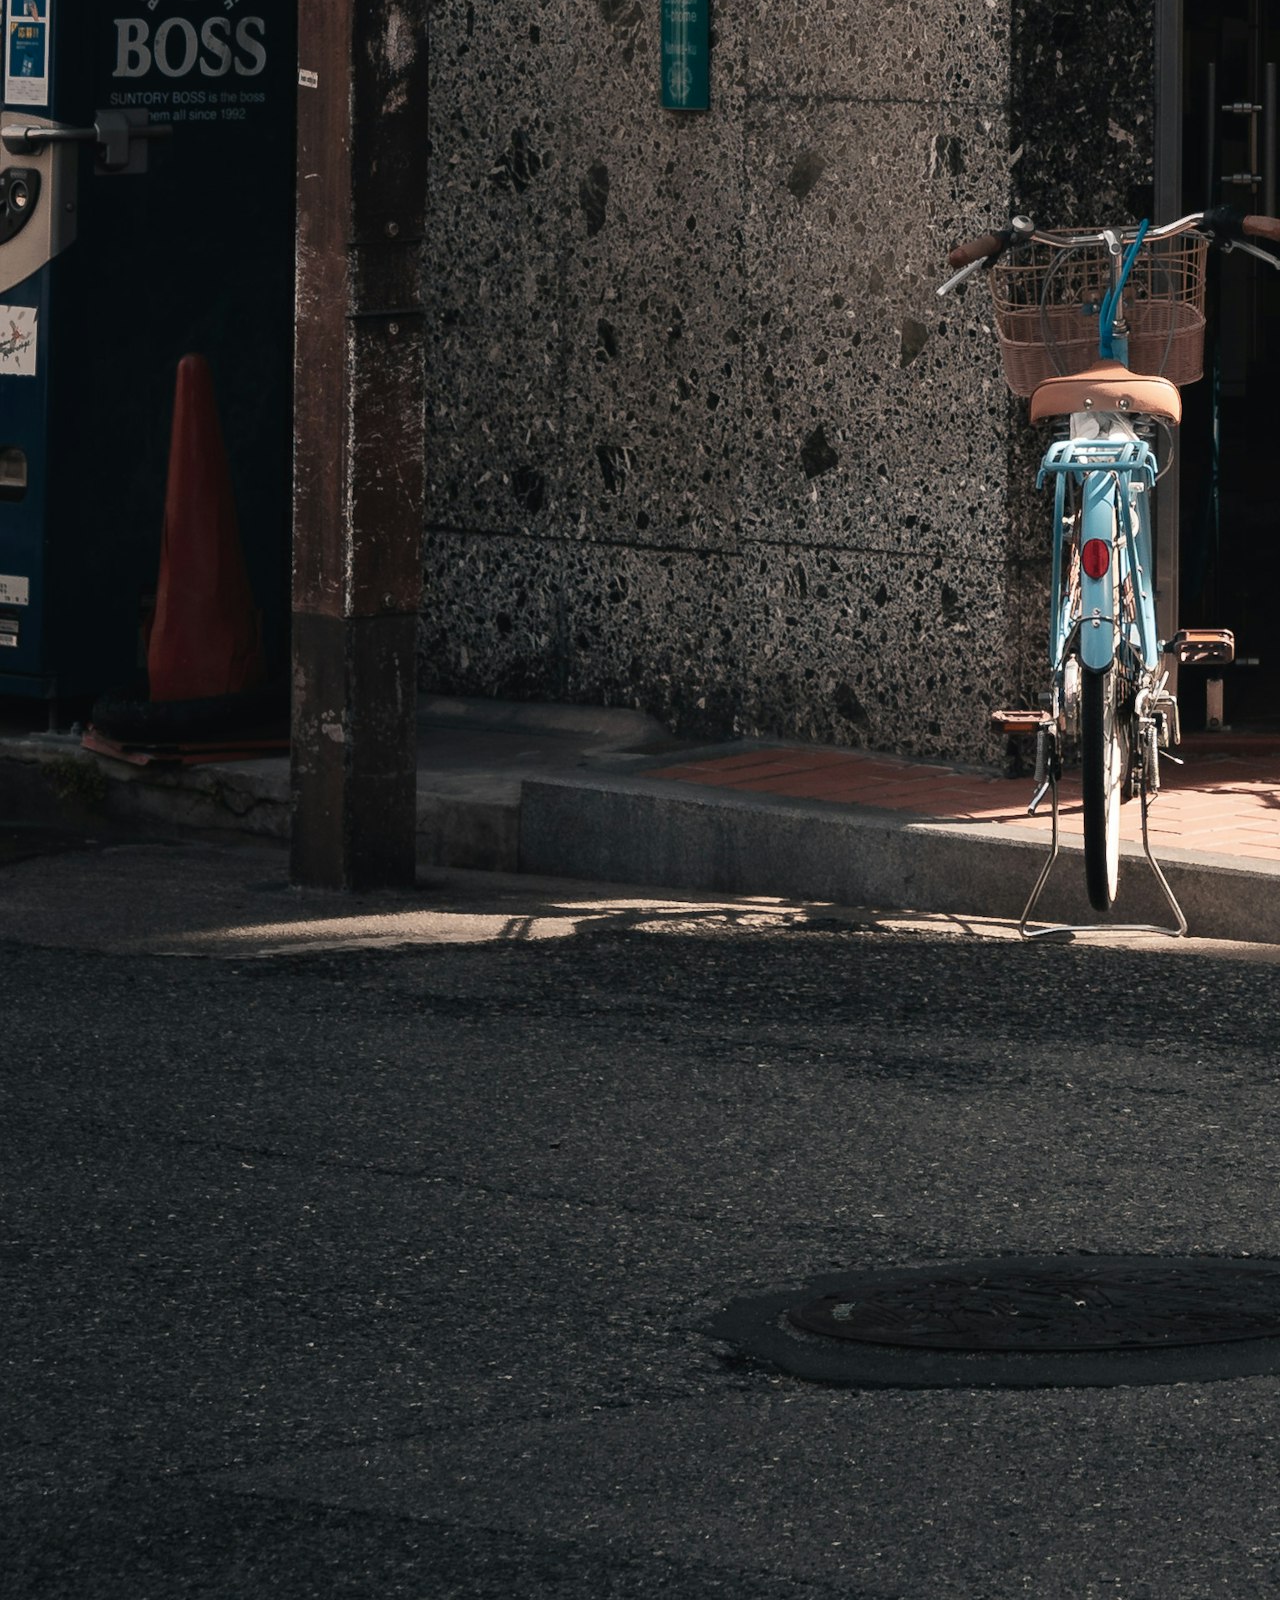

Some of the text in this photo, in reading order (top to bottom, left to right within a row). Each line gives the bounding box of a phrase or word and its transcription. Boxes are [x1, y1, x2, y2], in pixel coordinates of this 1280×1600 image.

[111, 15, 268, 78] BOSS
[109, 90, 266, 106] SUNTORY BOSS is the boss
[172, 108, 188, 121] all
[189, 108, 219, 121] since
[220, 108, 246, 121] 1992
